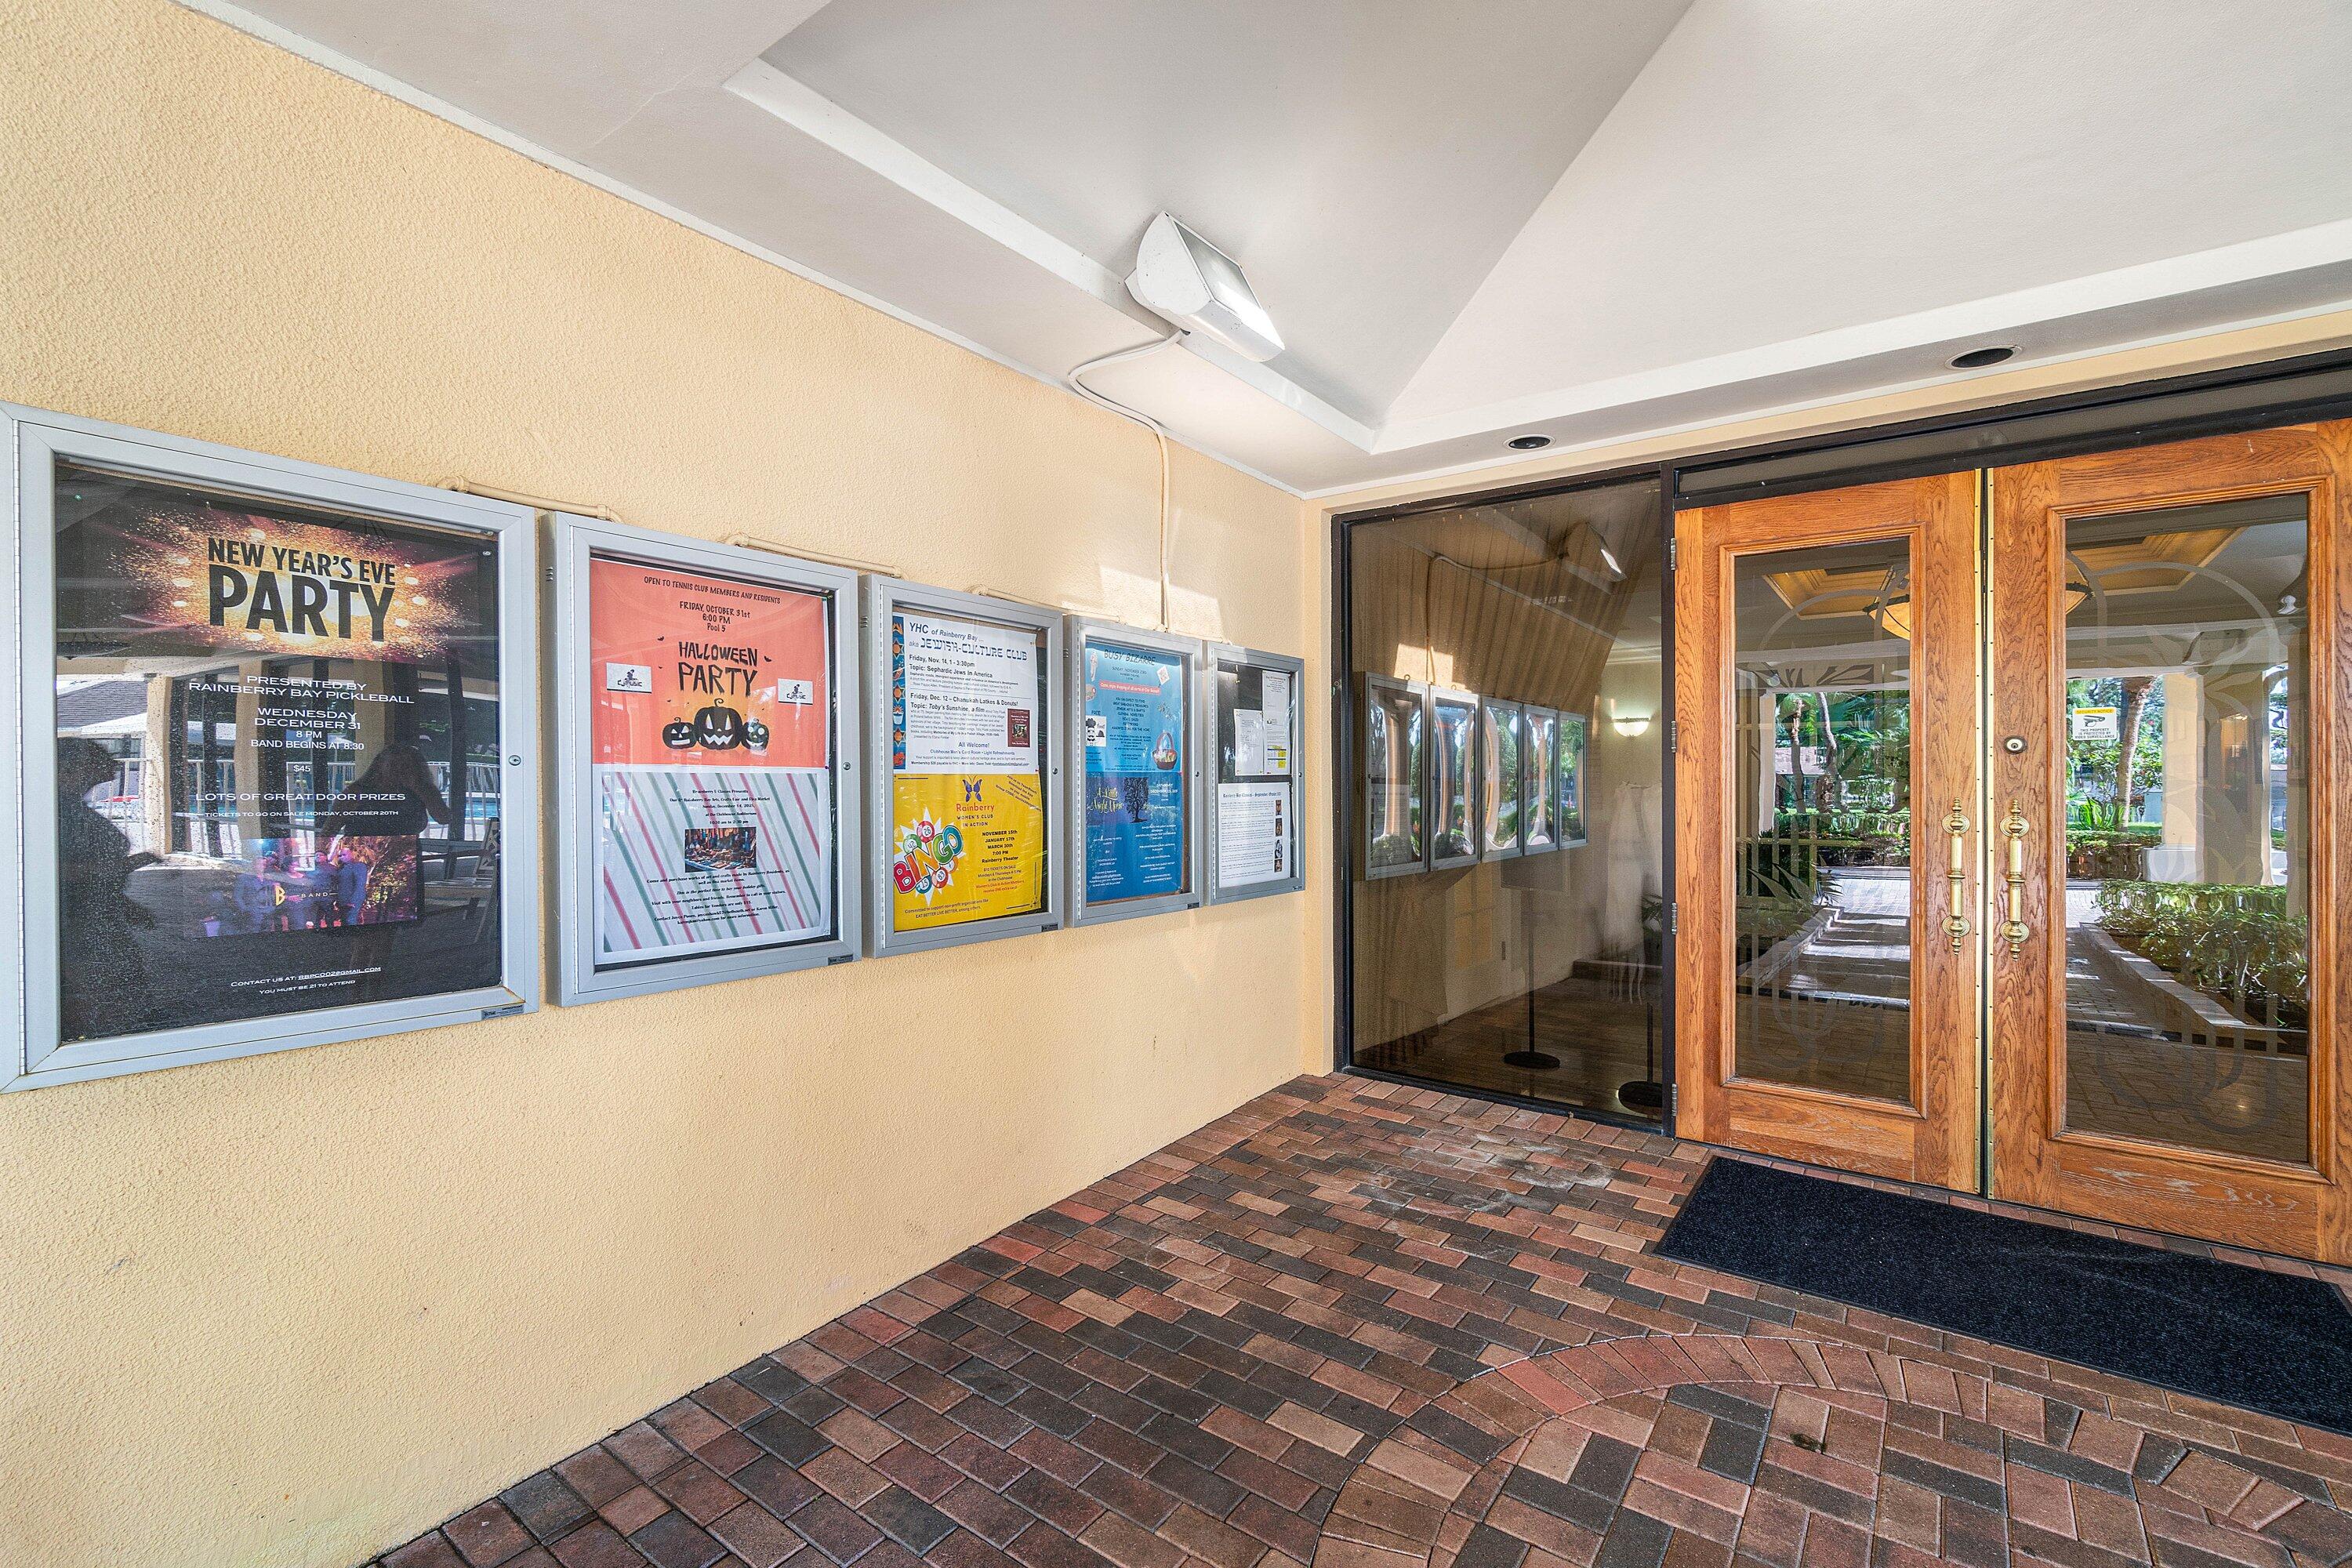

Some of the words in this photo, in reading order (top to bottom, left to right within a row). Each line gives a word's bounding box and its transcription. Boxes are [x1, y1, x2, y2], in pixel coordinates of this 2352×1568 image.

[209, 537, 265, 568] NEW
[272, 546, 353, 579] YEAR'S
[359, 560, 396, 585] EVE
[644, 576, 661, 586] OPEN
[672, 580, 693, 591] TENNIS
[694, 584, 709, 593] CLUB
[710, 586, 740, 598] MEMBERS
[753, 593, 781, 604] RESIDENTS
[209, 564, 395, 642] PARTY
[679, 601, 705, 612] FRIDAY,
[706, 604, 735, 616] OCTOBER
[736, 609, 750, 619] 31st
[702, 614, 717, 622] 6:00
[719, 615, 731, 625] PM
[706, 622, 720, 632] Pool
[909, 622, 929, 634] YHC
[939, 630, 966, 641] Rainberry
[967, 633, 978, 642] Bay
[678, 641, 758, 667] HALLOWEEN
[920, 637, 1004, 658] JEWISH-CULTURE
[1006, 649, 1027, 661] CLUB
[909, 654, 927, 663] Friday,
[1104, 649, 1123, 661] BUSY
[1125, 653, 1156, 666] BIZARRE
[909, 663, 926, 672] Topic:
[927, 666, 953, 674] Sephardic
[247, 676, 348, 690] PRESENTED
[678, 662, 758, 698] PARTY
[189, 682, 287, 696] RAINBERRY
[290, 689, 325, 699] BAY
[326, 691, 415, 704] PICKLEBALL
[910, 692, 929, 701] Friday,
[257, 707, 358, 719] WEDNESDAY
[254, 717, 345, 729] DECEMBER
[305, 730, 322, 739] PM
[251, 739, 283, 749] BAND
[285, 740, 327, 750] BEGINS
[343, 742, 365, 750] 8:30
[293, 764, 311, 773] $45
[359, 793, 406, 801] PRIZES
[956, 803, 995, 812] Rainberry
[894, 826, 964, 894] BINGO
[230, 978, 270, 988] CONTACT
